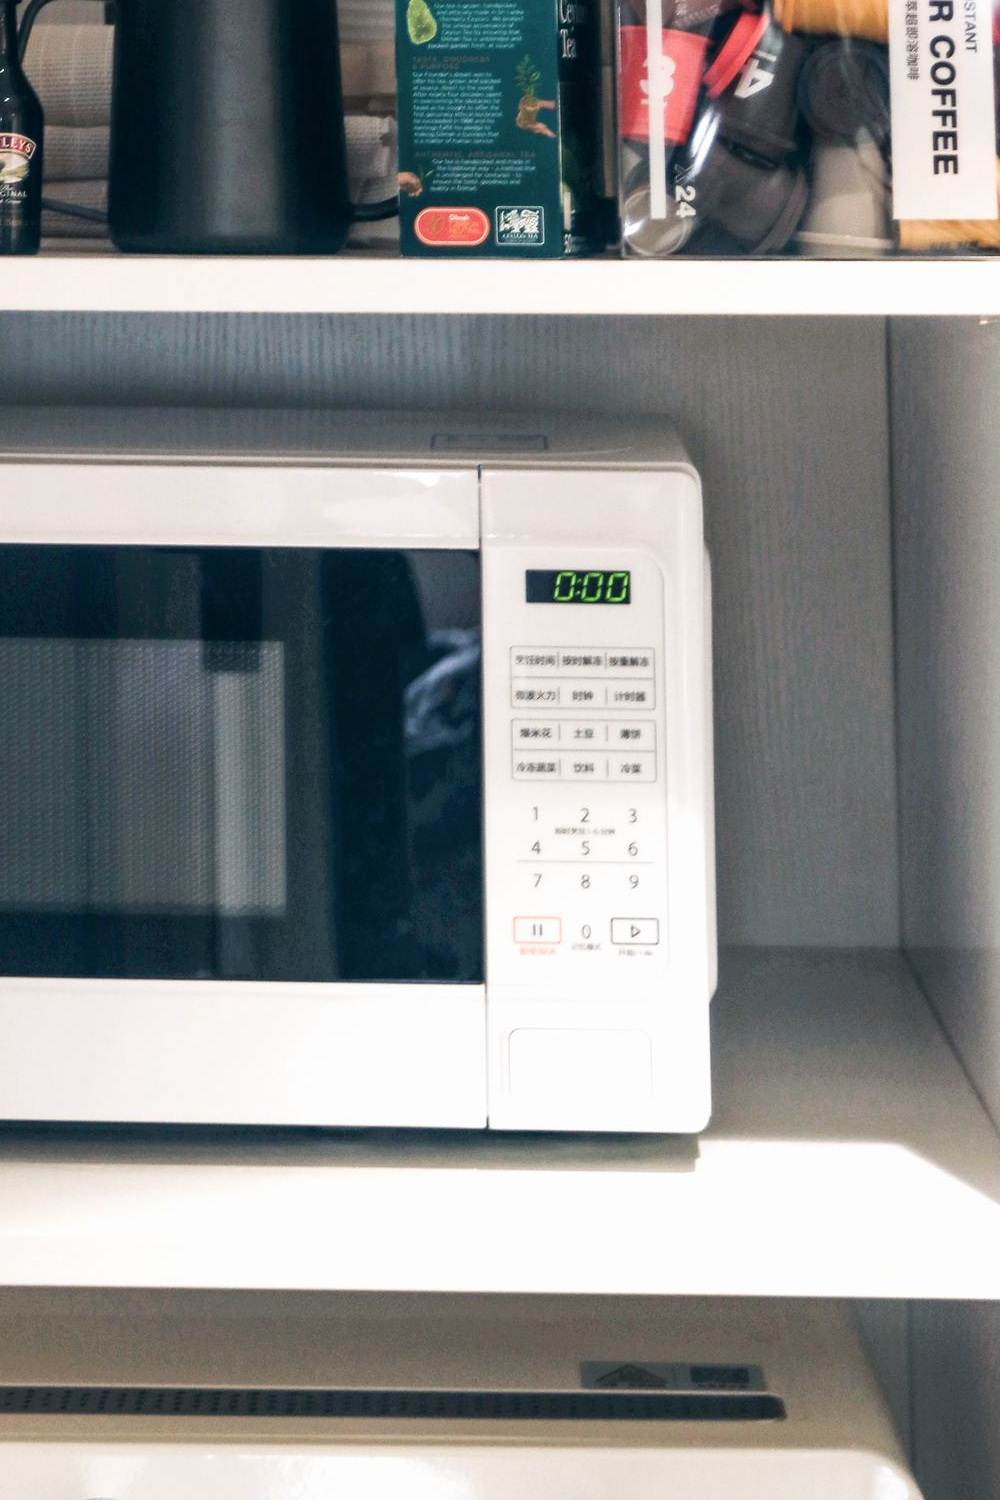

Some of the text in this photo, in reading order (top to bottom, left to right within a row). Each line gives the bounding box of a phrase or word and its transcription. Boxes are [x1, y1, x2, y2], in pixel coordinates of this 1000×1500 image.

[560, 28, 578, 58] Tea
[929, 34, 959, 176] COFFEE
[553, 571, 630, 602] 0:00
[532, 805, 540, 821] 1
[580, 807, 590, 823] 2
[628, 808, 638, 824] 3
[531, 840, 541, 855] 4
[581, 841, 590, 856] 5
[628, 841, 639, 857] 6
[533, 873, 542, 888] 7
[580, 873, 591, 889] 8
[628, 874, 639, 889] 9
[581, 924, 591, 939] 0
